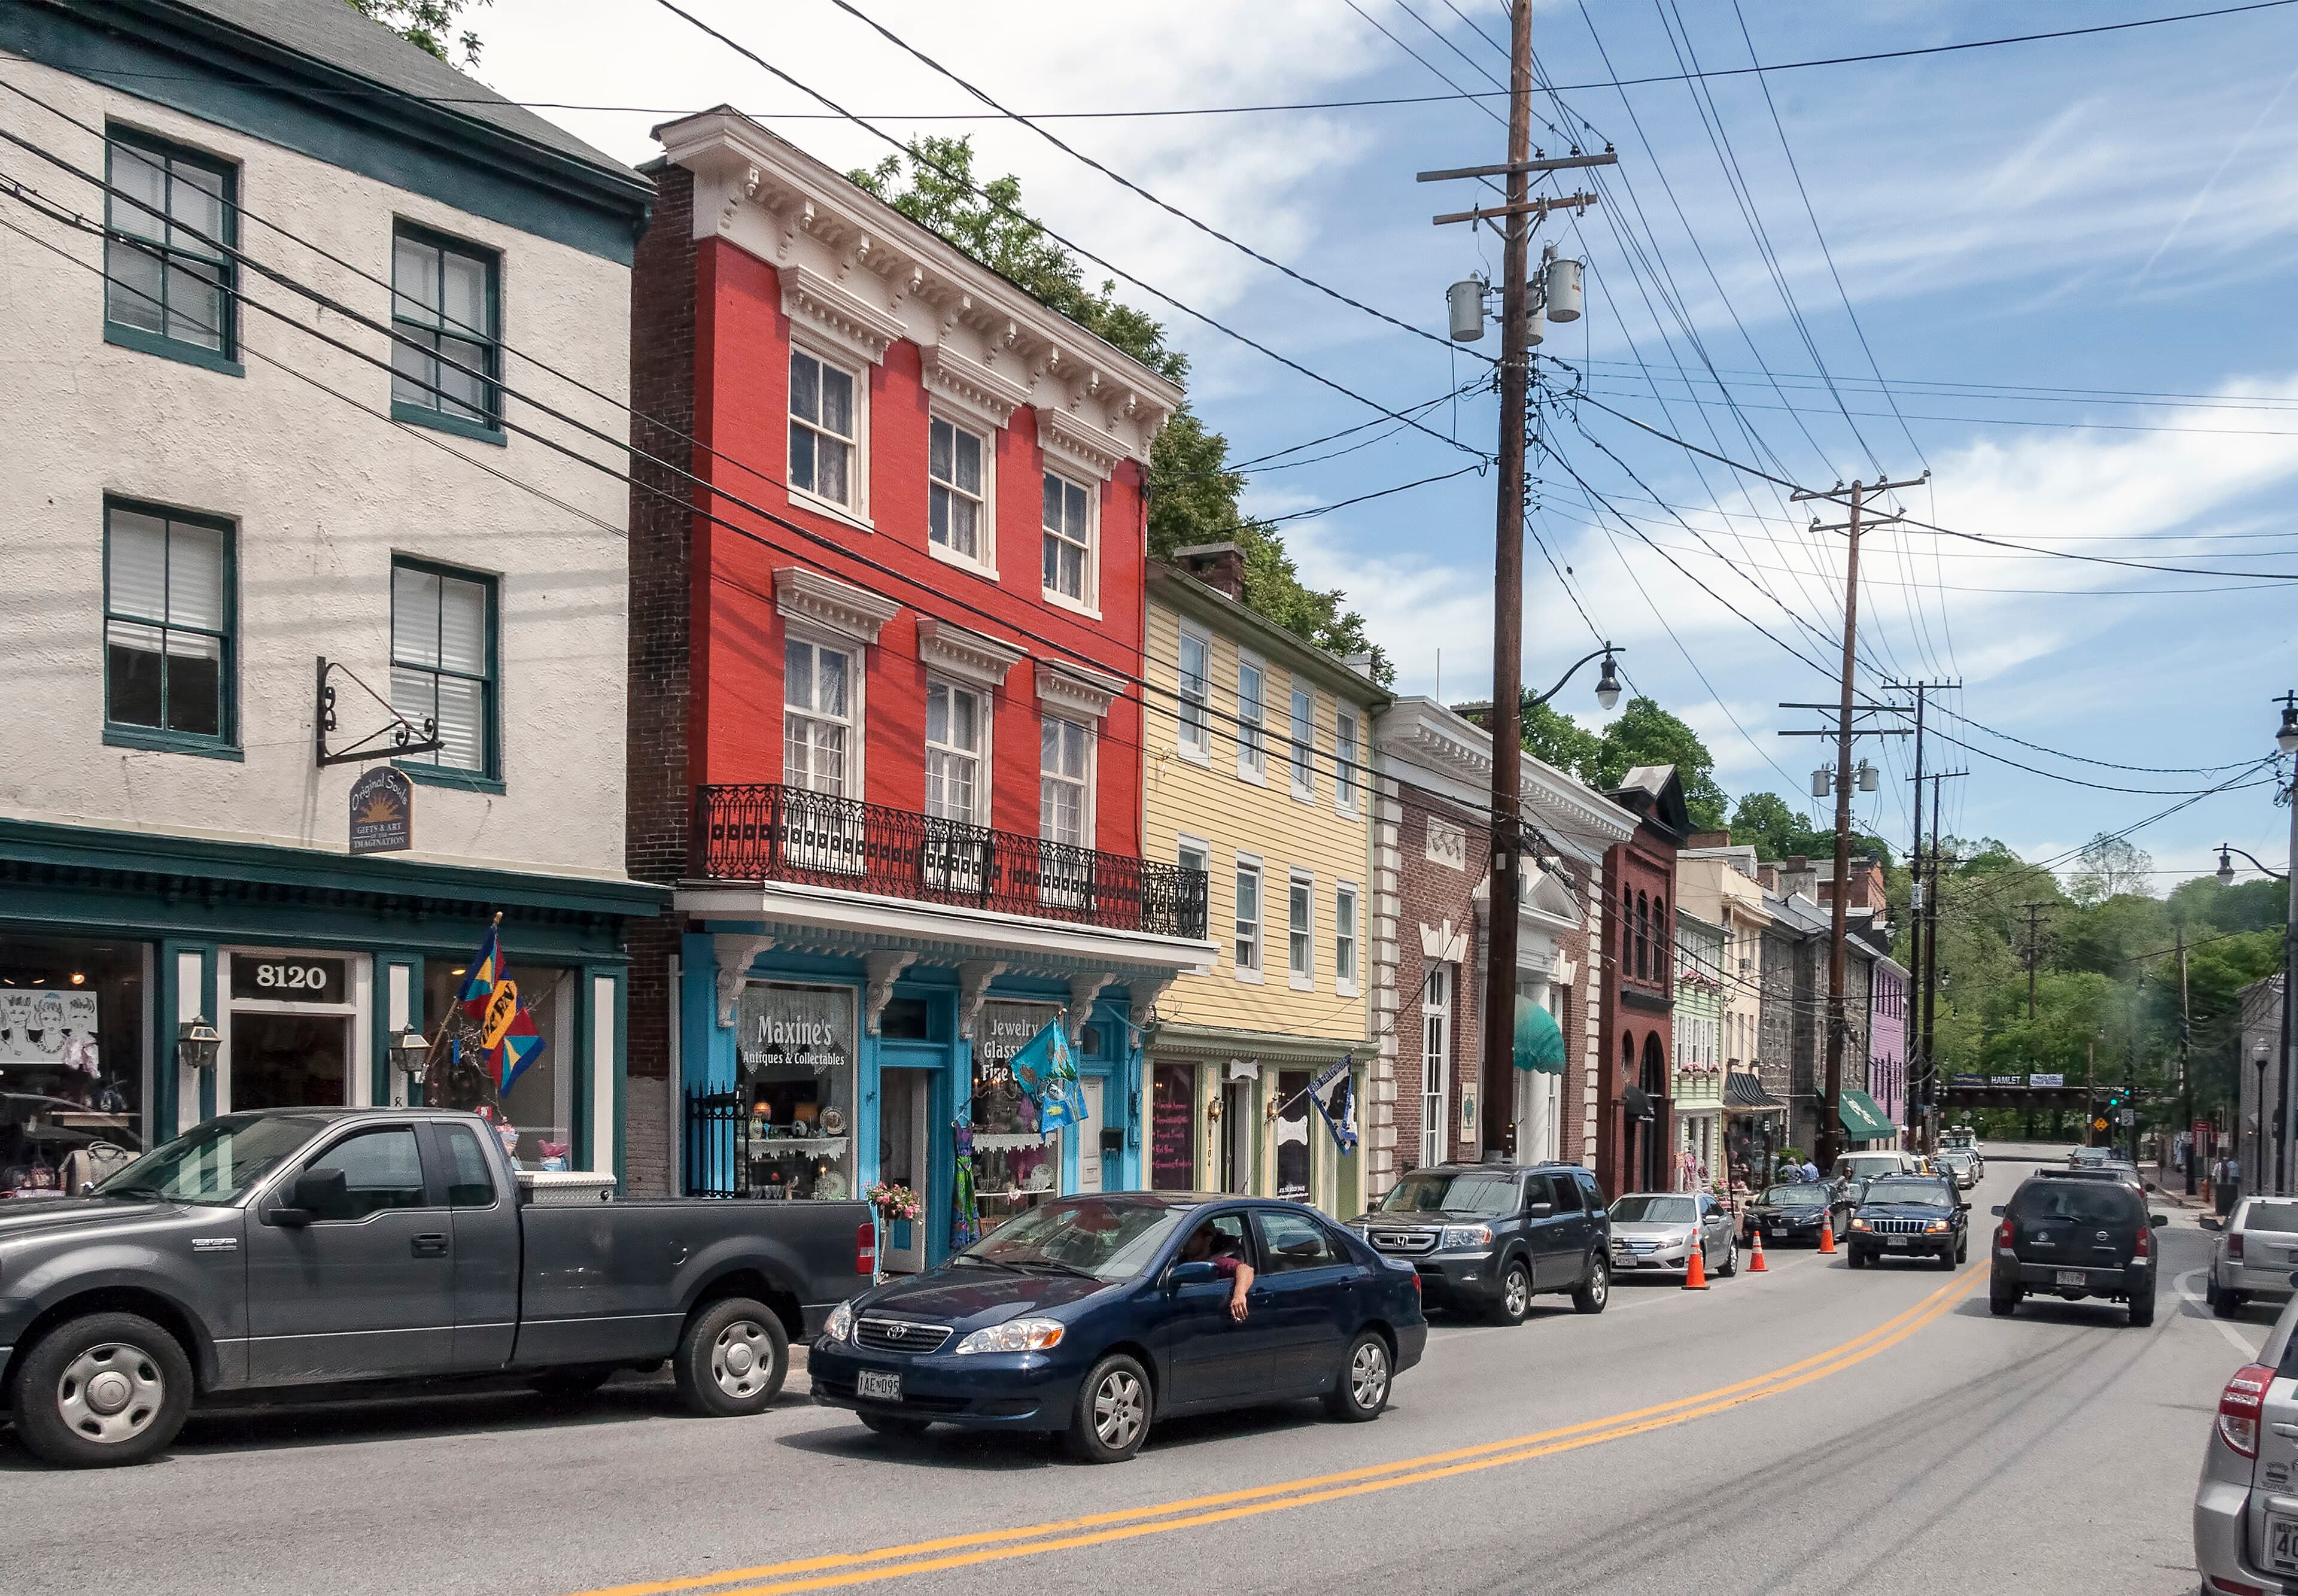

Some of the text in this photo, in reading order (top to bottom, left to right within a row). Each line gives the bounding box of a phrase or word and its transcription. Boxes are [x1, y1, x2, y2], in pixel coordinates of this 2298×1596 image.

[352, 773, 385, 811] Original
[357, 825, 378, 834] GIFTS
[387, 822, 402, 831] ART
[354, 836, 405, 849] IMAGINATION
[257, 965, 327, 989] 8120
[482, 981, 515, 1045] OPEN
[758, 1015, 832, 1046] Maxine's
[990, 1019, 1039, 1038] Jewelry
[743, 1051, 845, 1066] Antiques & Collectables
[982, 1063, 1008, 1081] Fine
[1991, 1076, 2022, 1085] HAMLET
